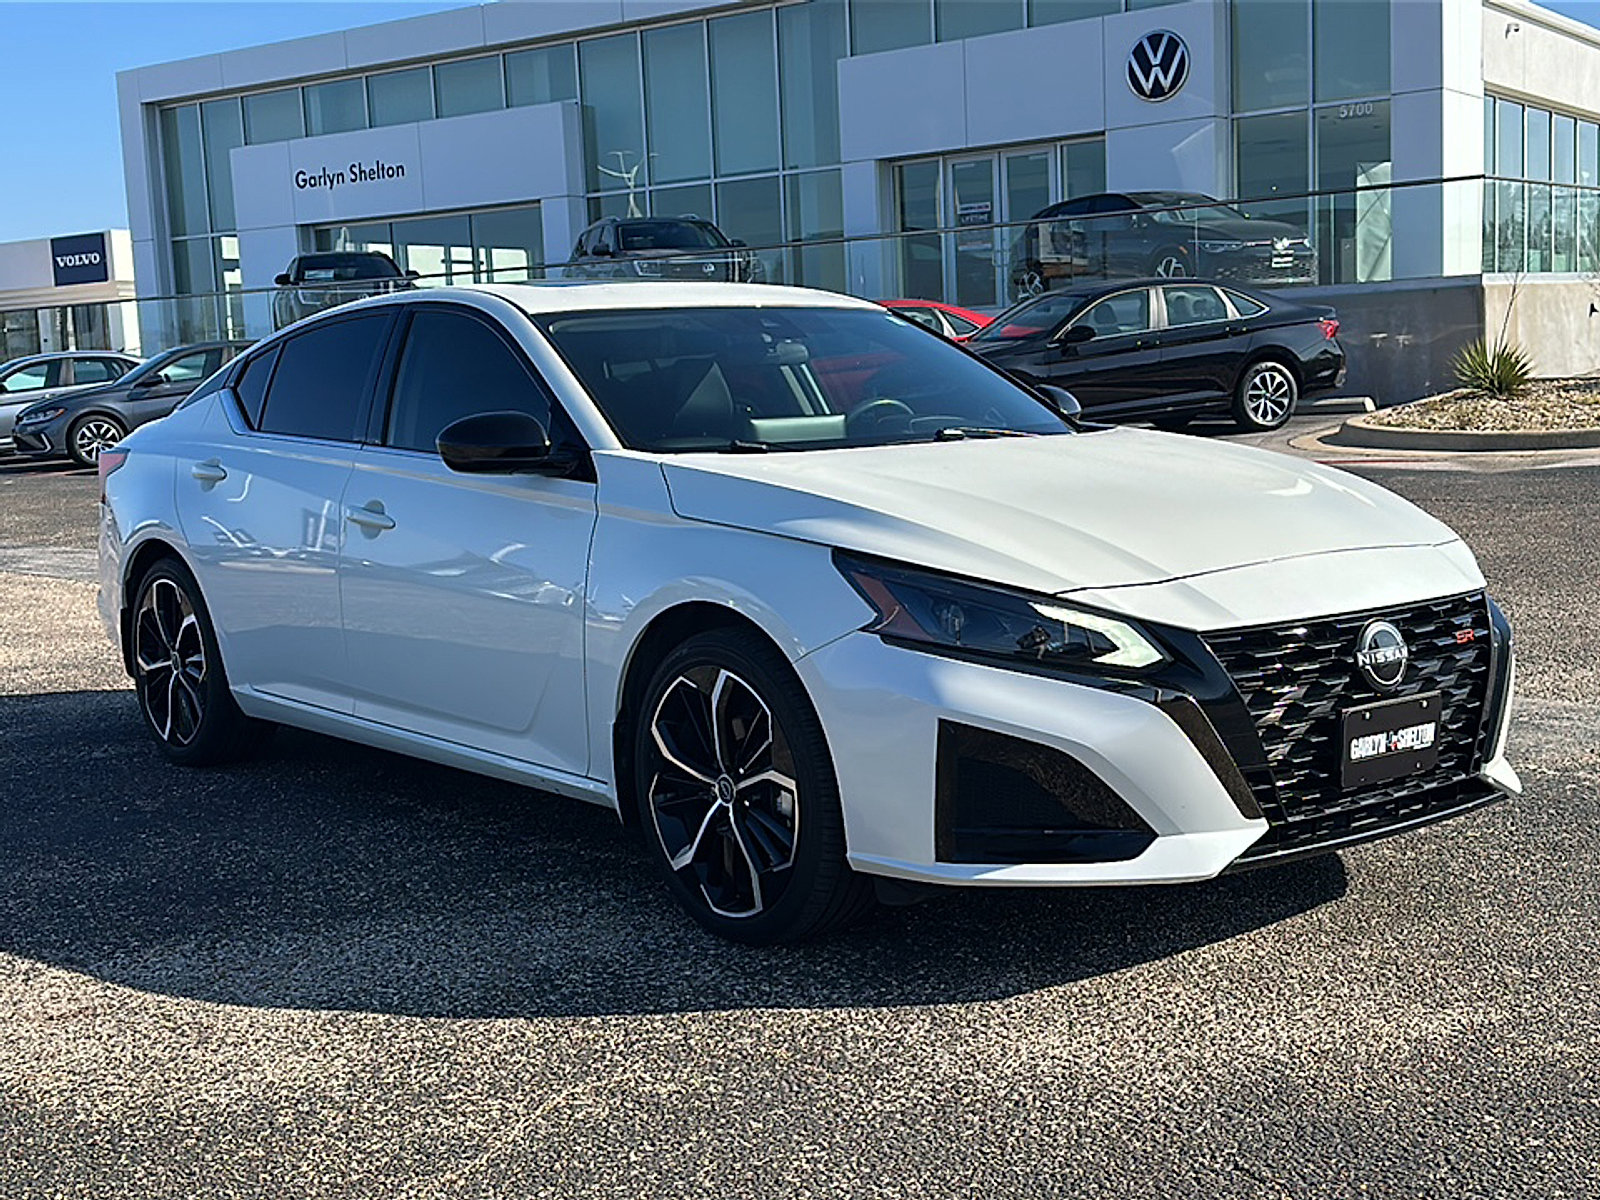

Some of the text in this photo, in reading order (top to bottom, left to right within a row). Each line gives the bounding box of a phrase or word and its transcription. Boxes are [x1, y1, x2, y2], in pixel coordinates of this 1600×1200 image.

[1340, 102, 1373, 118] 5700
[295, 160, 405, 190] Garlyn Shelton
[55, 252, 101, 267] VOLVO
[1456, 628, 1474, 644] SR
[1357, 645, 1408, 668] NISSAN
